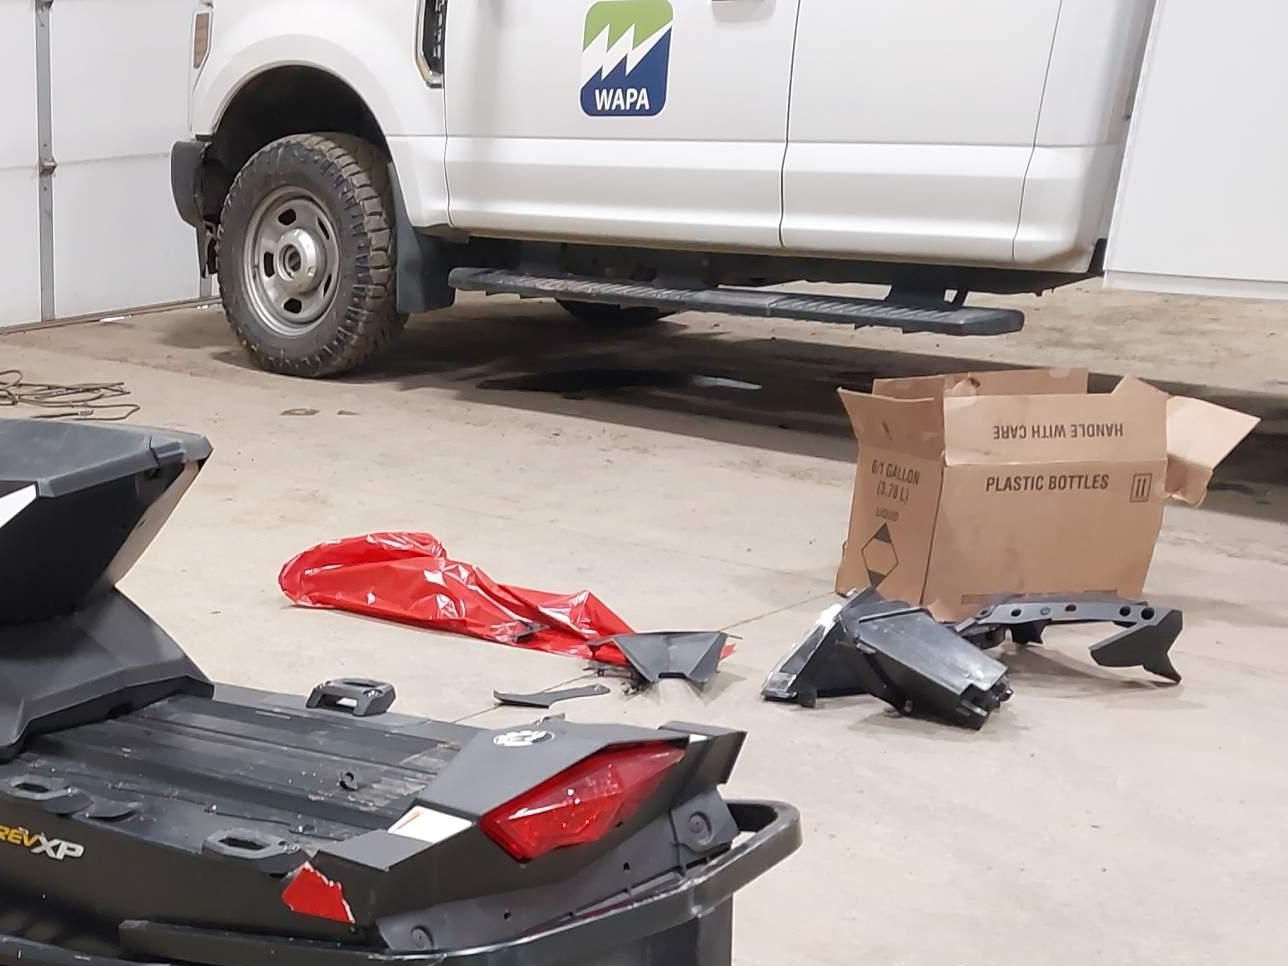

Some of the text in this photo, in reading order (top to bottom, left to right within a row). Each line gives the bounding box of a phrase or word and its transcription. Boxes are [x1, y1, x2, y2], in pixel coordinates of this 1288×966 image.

[594, 87, 650, 111] WAPA
[992, 423, 1124, 440] HANDLE WITH CARE
[885, 462, 921, 486] GALLON
[985, 474, 1109, 492] PLASTIC BOTTLES
